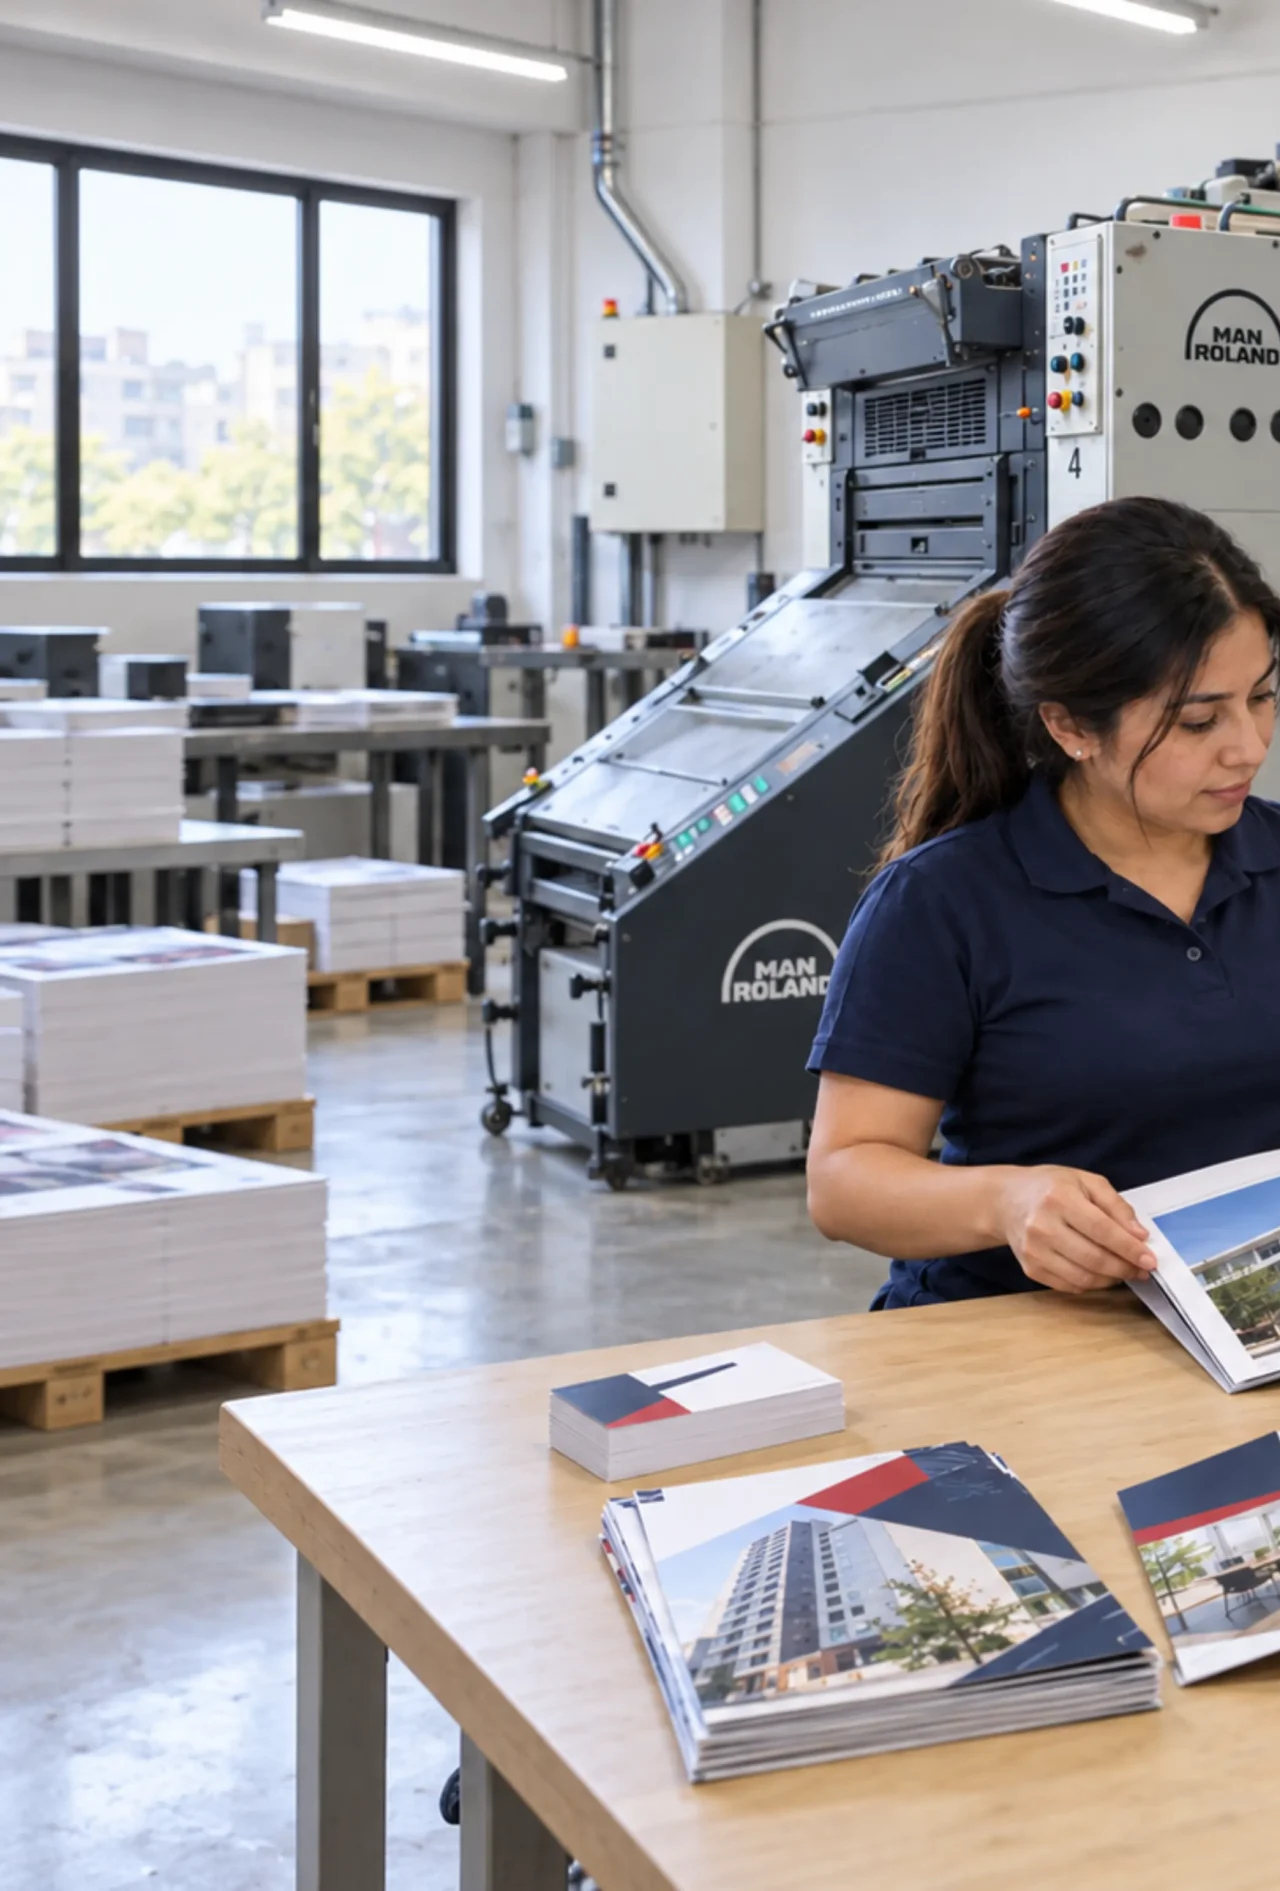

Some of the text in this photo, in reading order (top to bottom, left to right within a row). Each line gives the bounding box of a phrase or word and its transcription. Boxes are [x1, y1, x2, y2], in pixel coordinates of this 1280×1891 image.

[1213, 326, 1262, 346] MAN
[1195, 344, 1280, 366] ROLAND
[1068, 447, 1082, 479] 4
[755, 957, 817, 980] MAN
